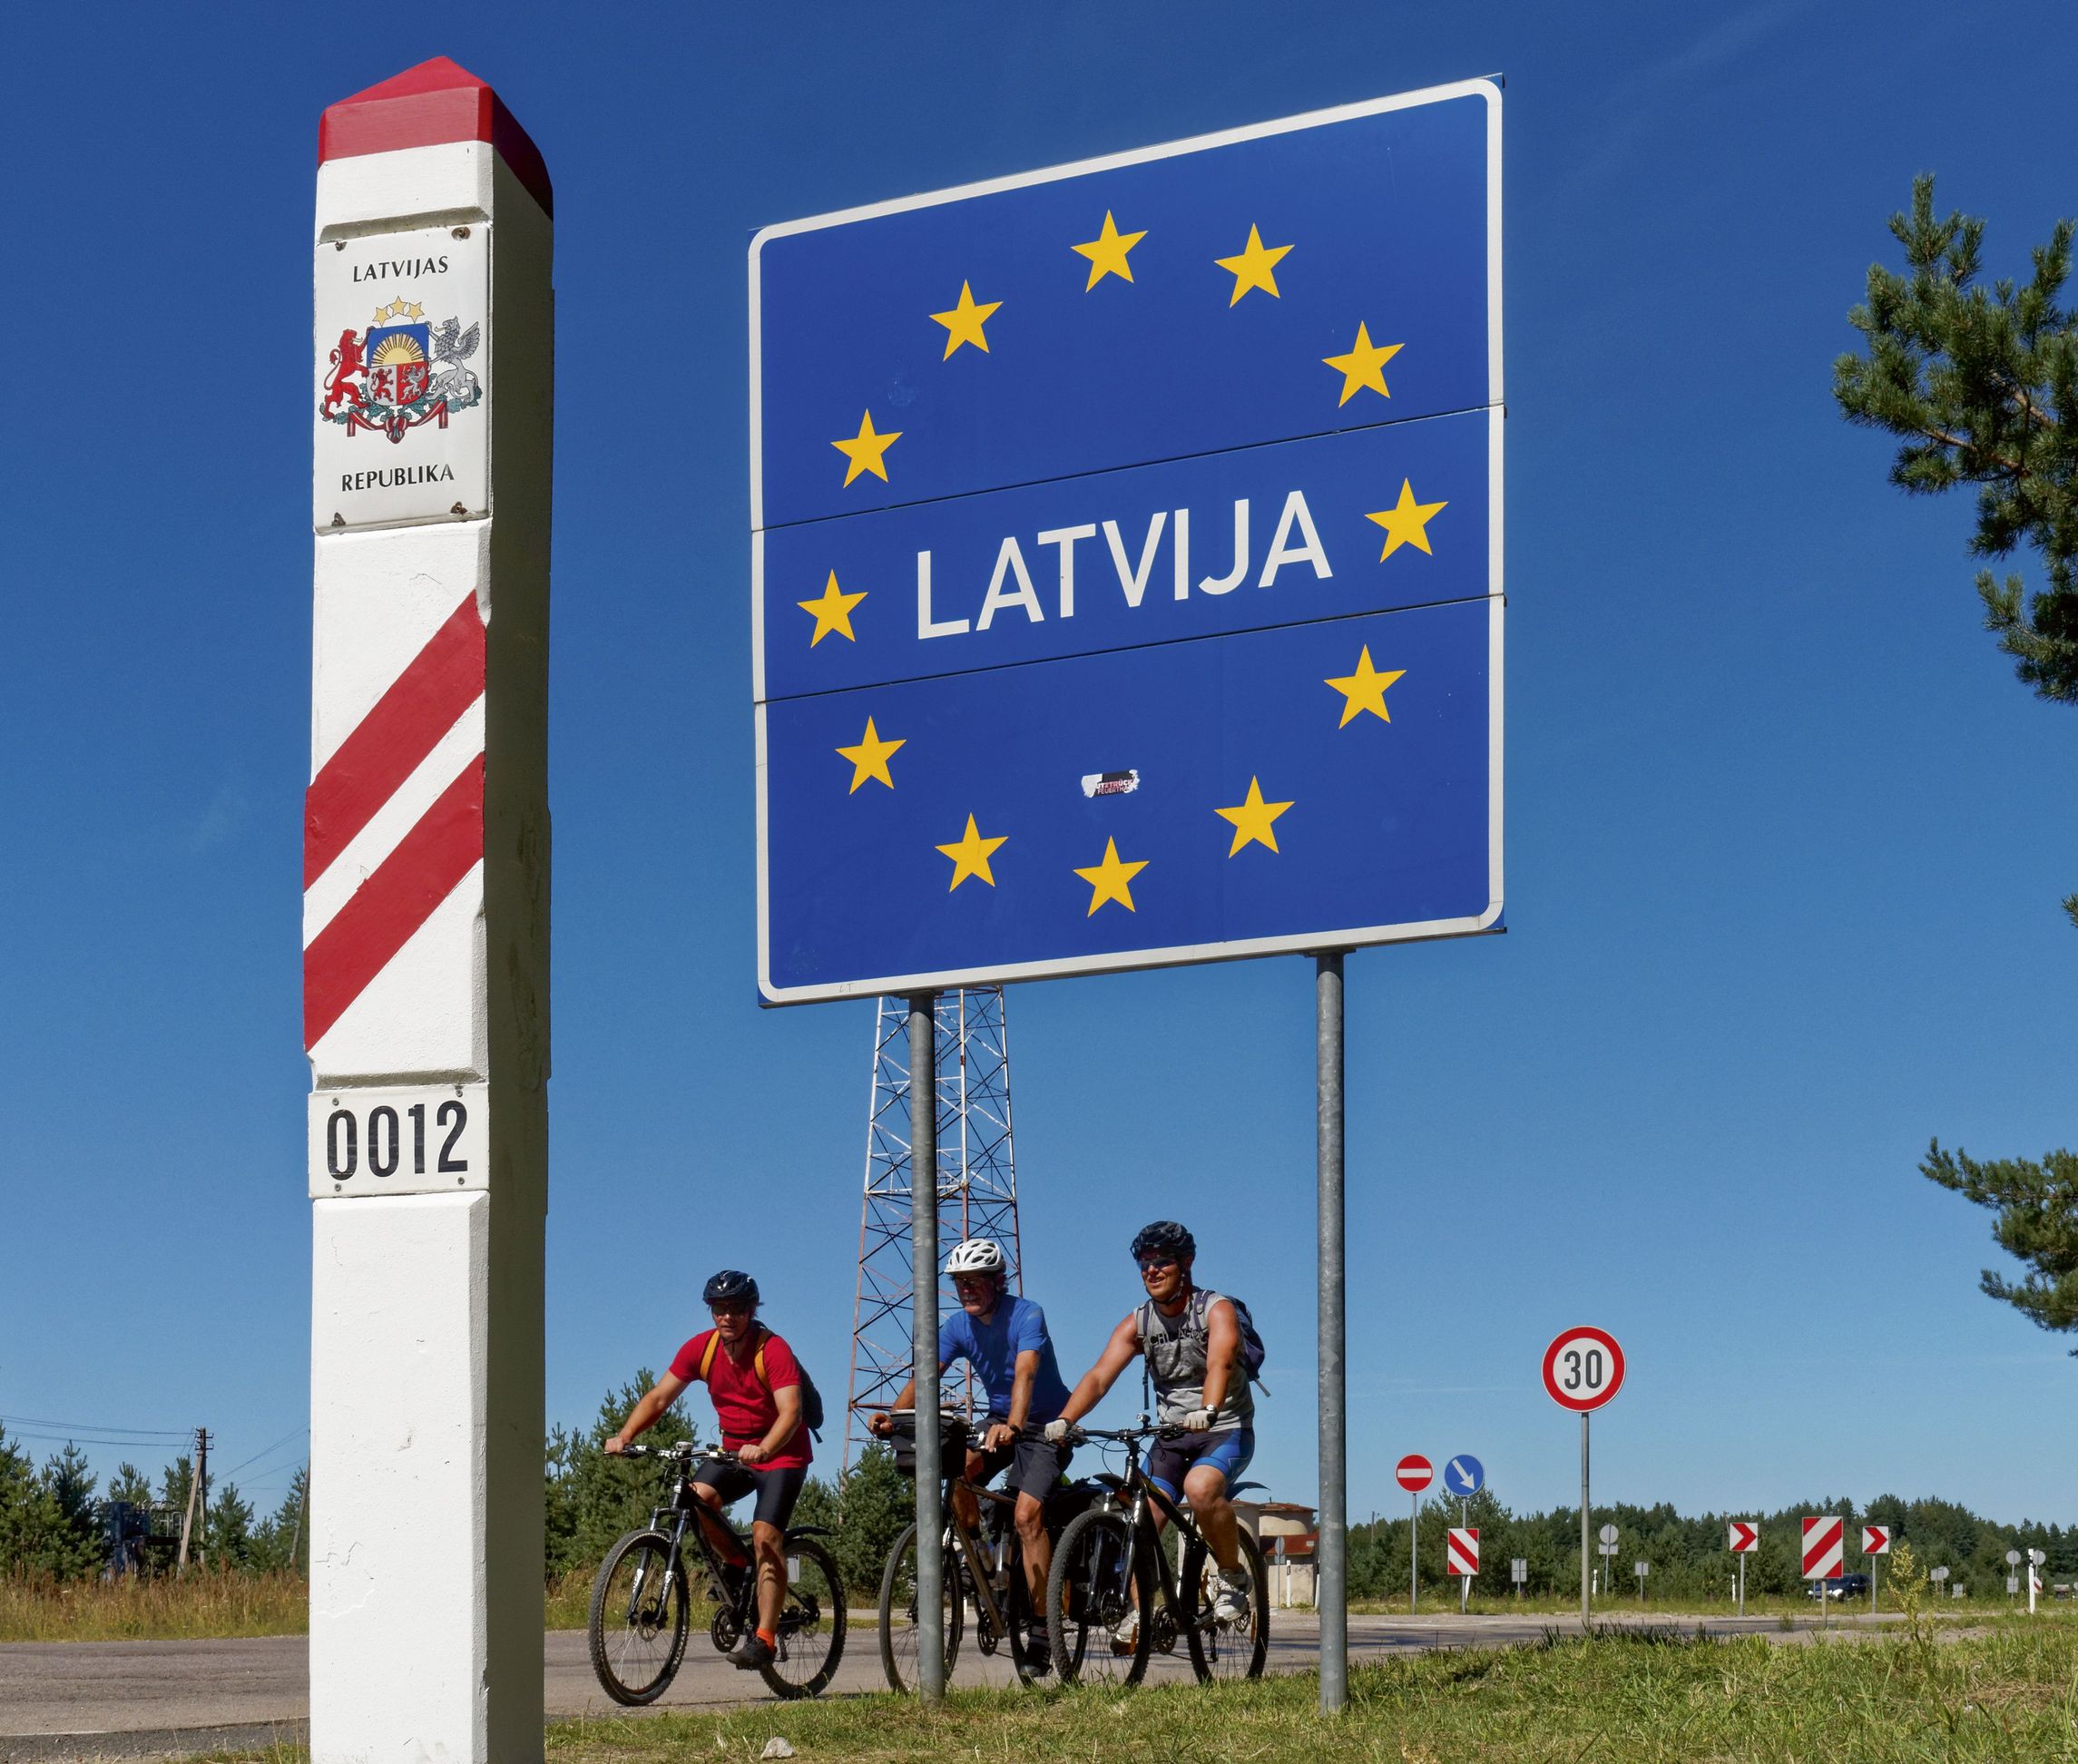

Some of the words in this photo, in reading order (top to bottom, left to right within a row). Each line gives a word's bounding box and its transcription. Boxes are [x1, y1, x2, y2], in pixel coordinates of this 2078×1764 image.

[353, 256, 449, 282] LATVIJAS
[341, 464, 455, 492] REPUBLIKA
[917, 490, 1333, 640] LATVIJA
[327, 1100, 468, 1181] 0012
[1563, 1348, 1603, 1390] 30
